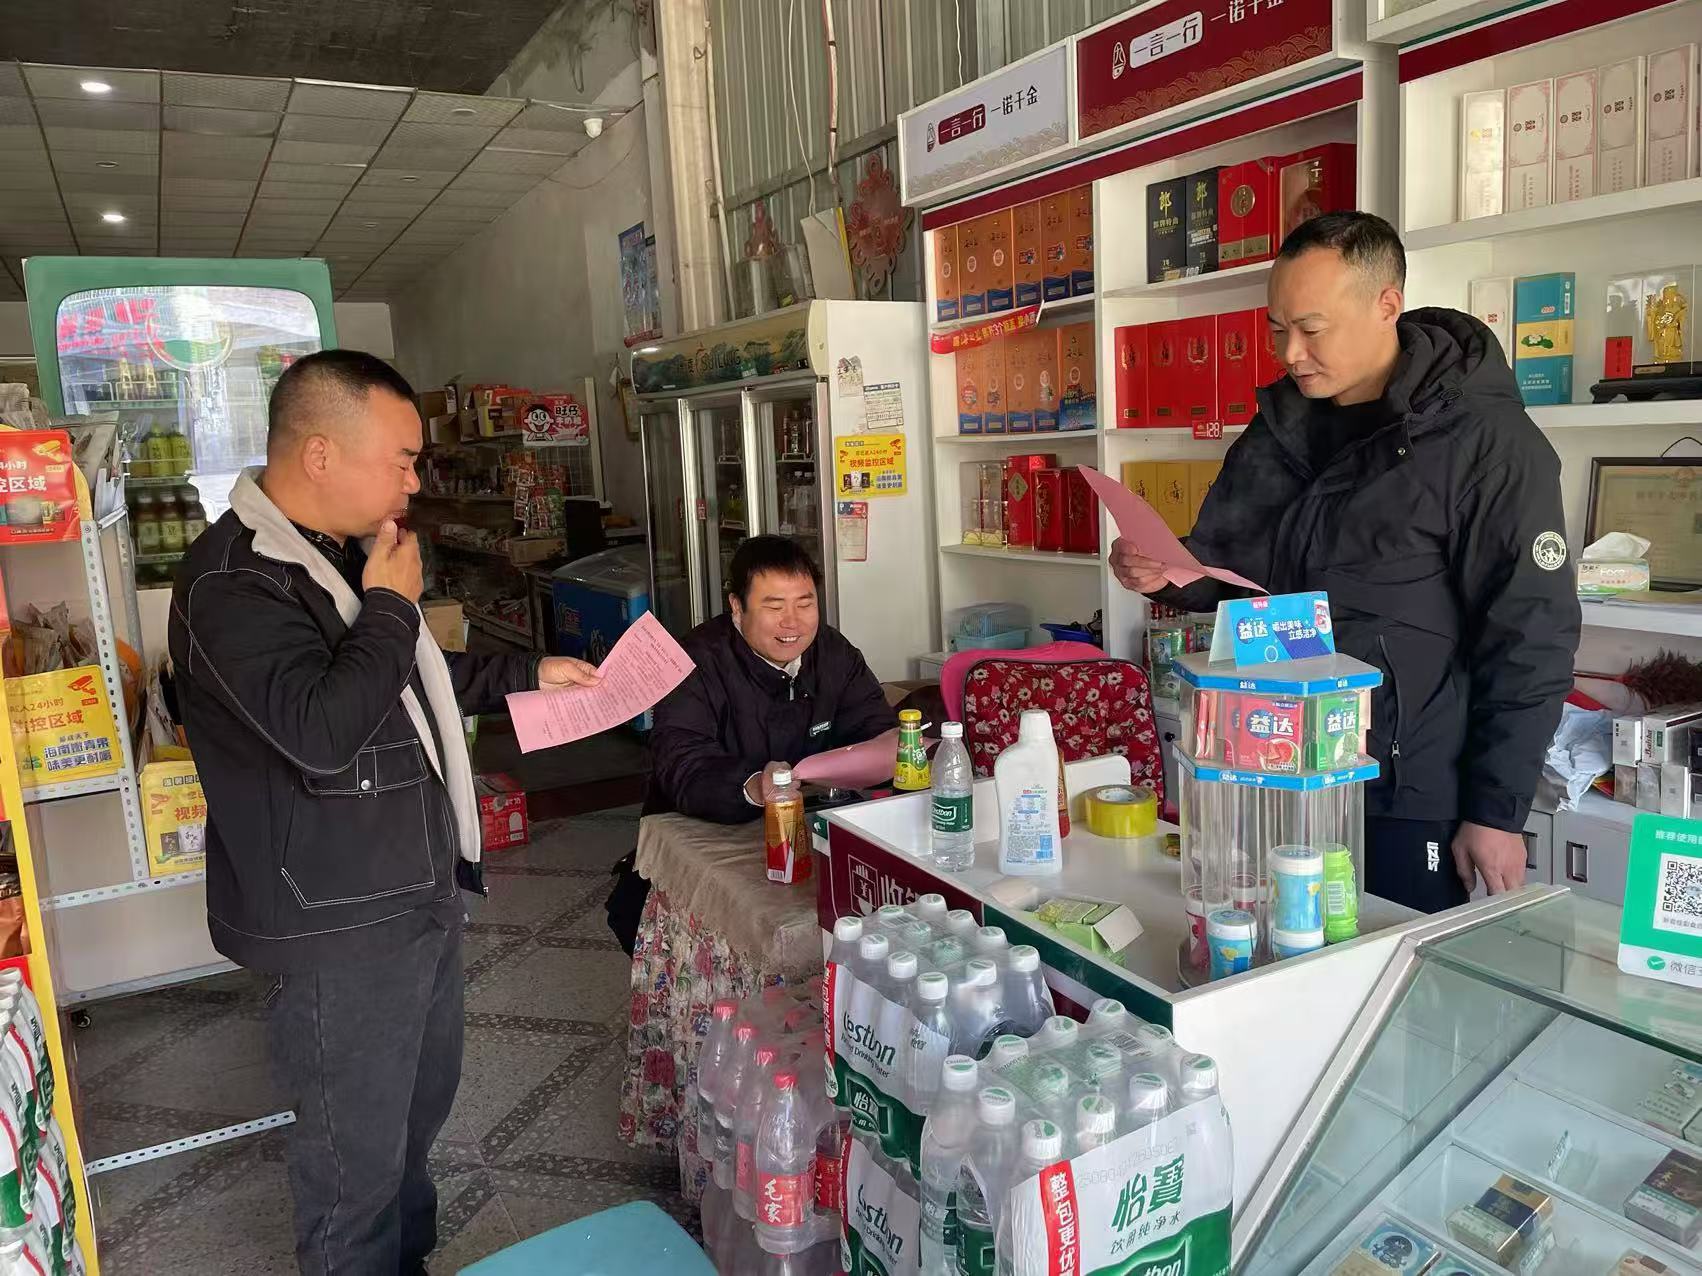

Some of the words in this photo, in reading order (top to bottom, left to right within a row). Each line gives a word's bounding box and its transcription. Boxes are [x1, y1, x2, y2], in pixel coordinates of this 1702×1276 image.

[1134, 17, 1198, 56] 一言一行
[941, 107, 983, 137] 一言一行
[991, 85, 1038, 115] 一诺千金
[1239, 621, 1268, 639] 益达
[1250, 714, 1294, 736] 益达
[1327, 712, 1355, 732] 益达
[174, 804, 206, 821] 视频
[1111, 1153, 1185, 1233] 怡寶
[1050, 1172, 1077, 1276] 整包更优
